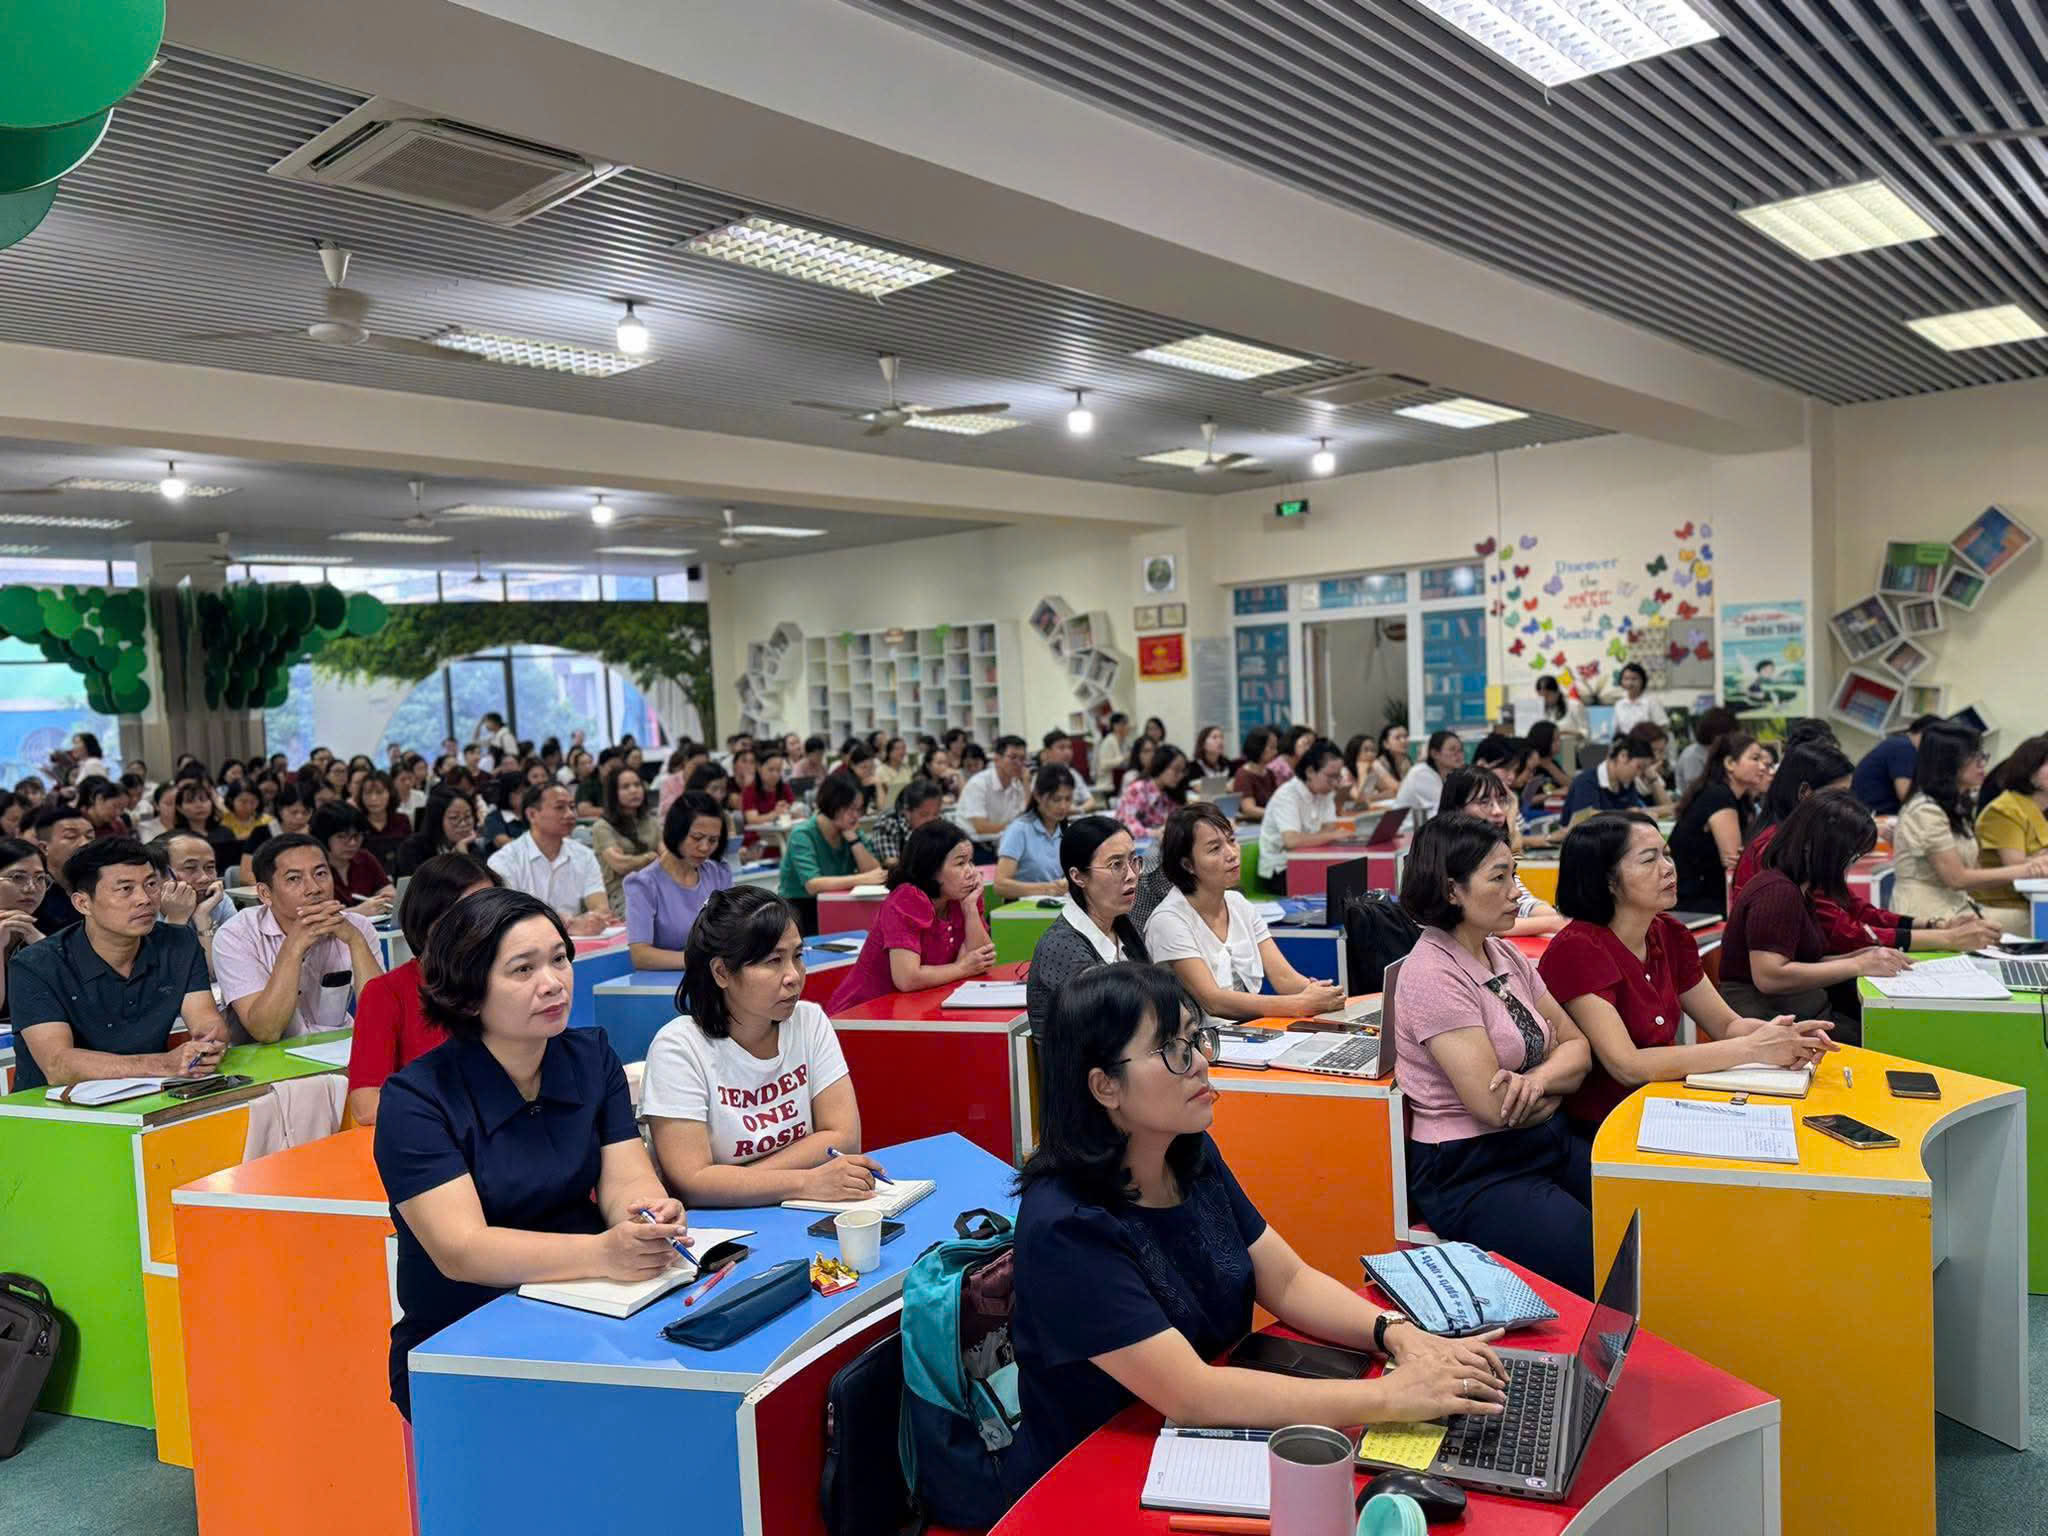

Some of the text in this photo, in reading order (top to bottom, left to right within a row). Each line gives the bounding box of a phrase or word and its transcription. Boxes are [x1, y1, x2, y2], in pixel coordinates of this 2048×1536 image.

[717, 1063, 809, 1109] TENDER
[742, 1099, 799, 1133] ONE
[733, 1121, 808, 1158] ROSE
